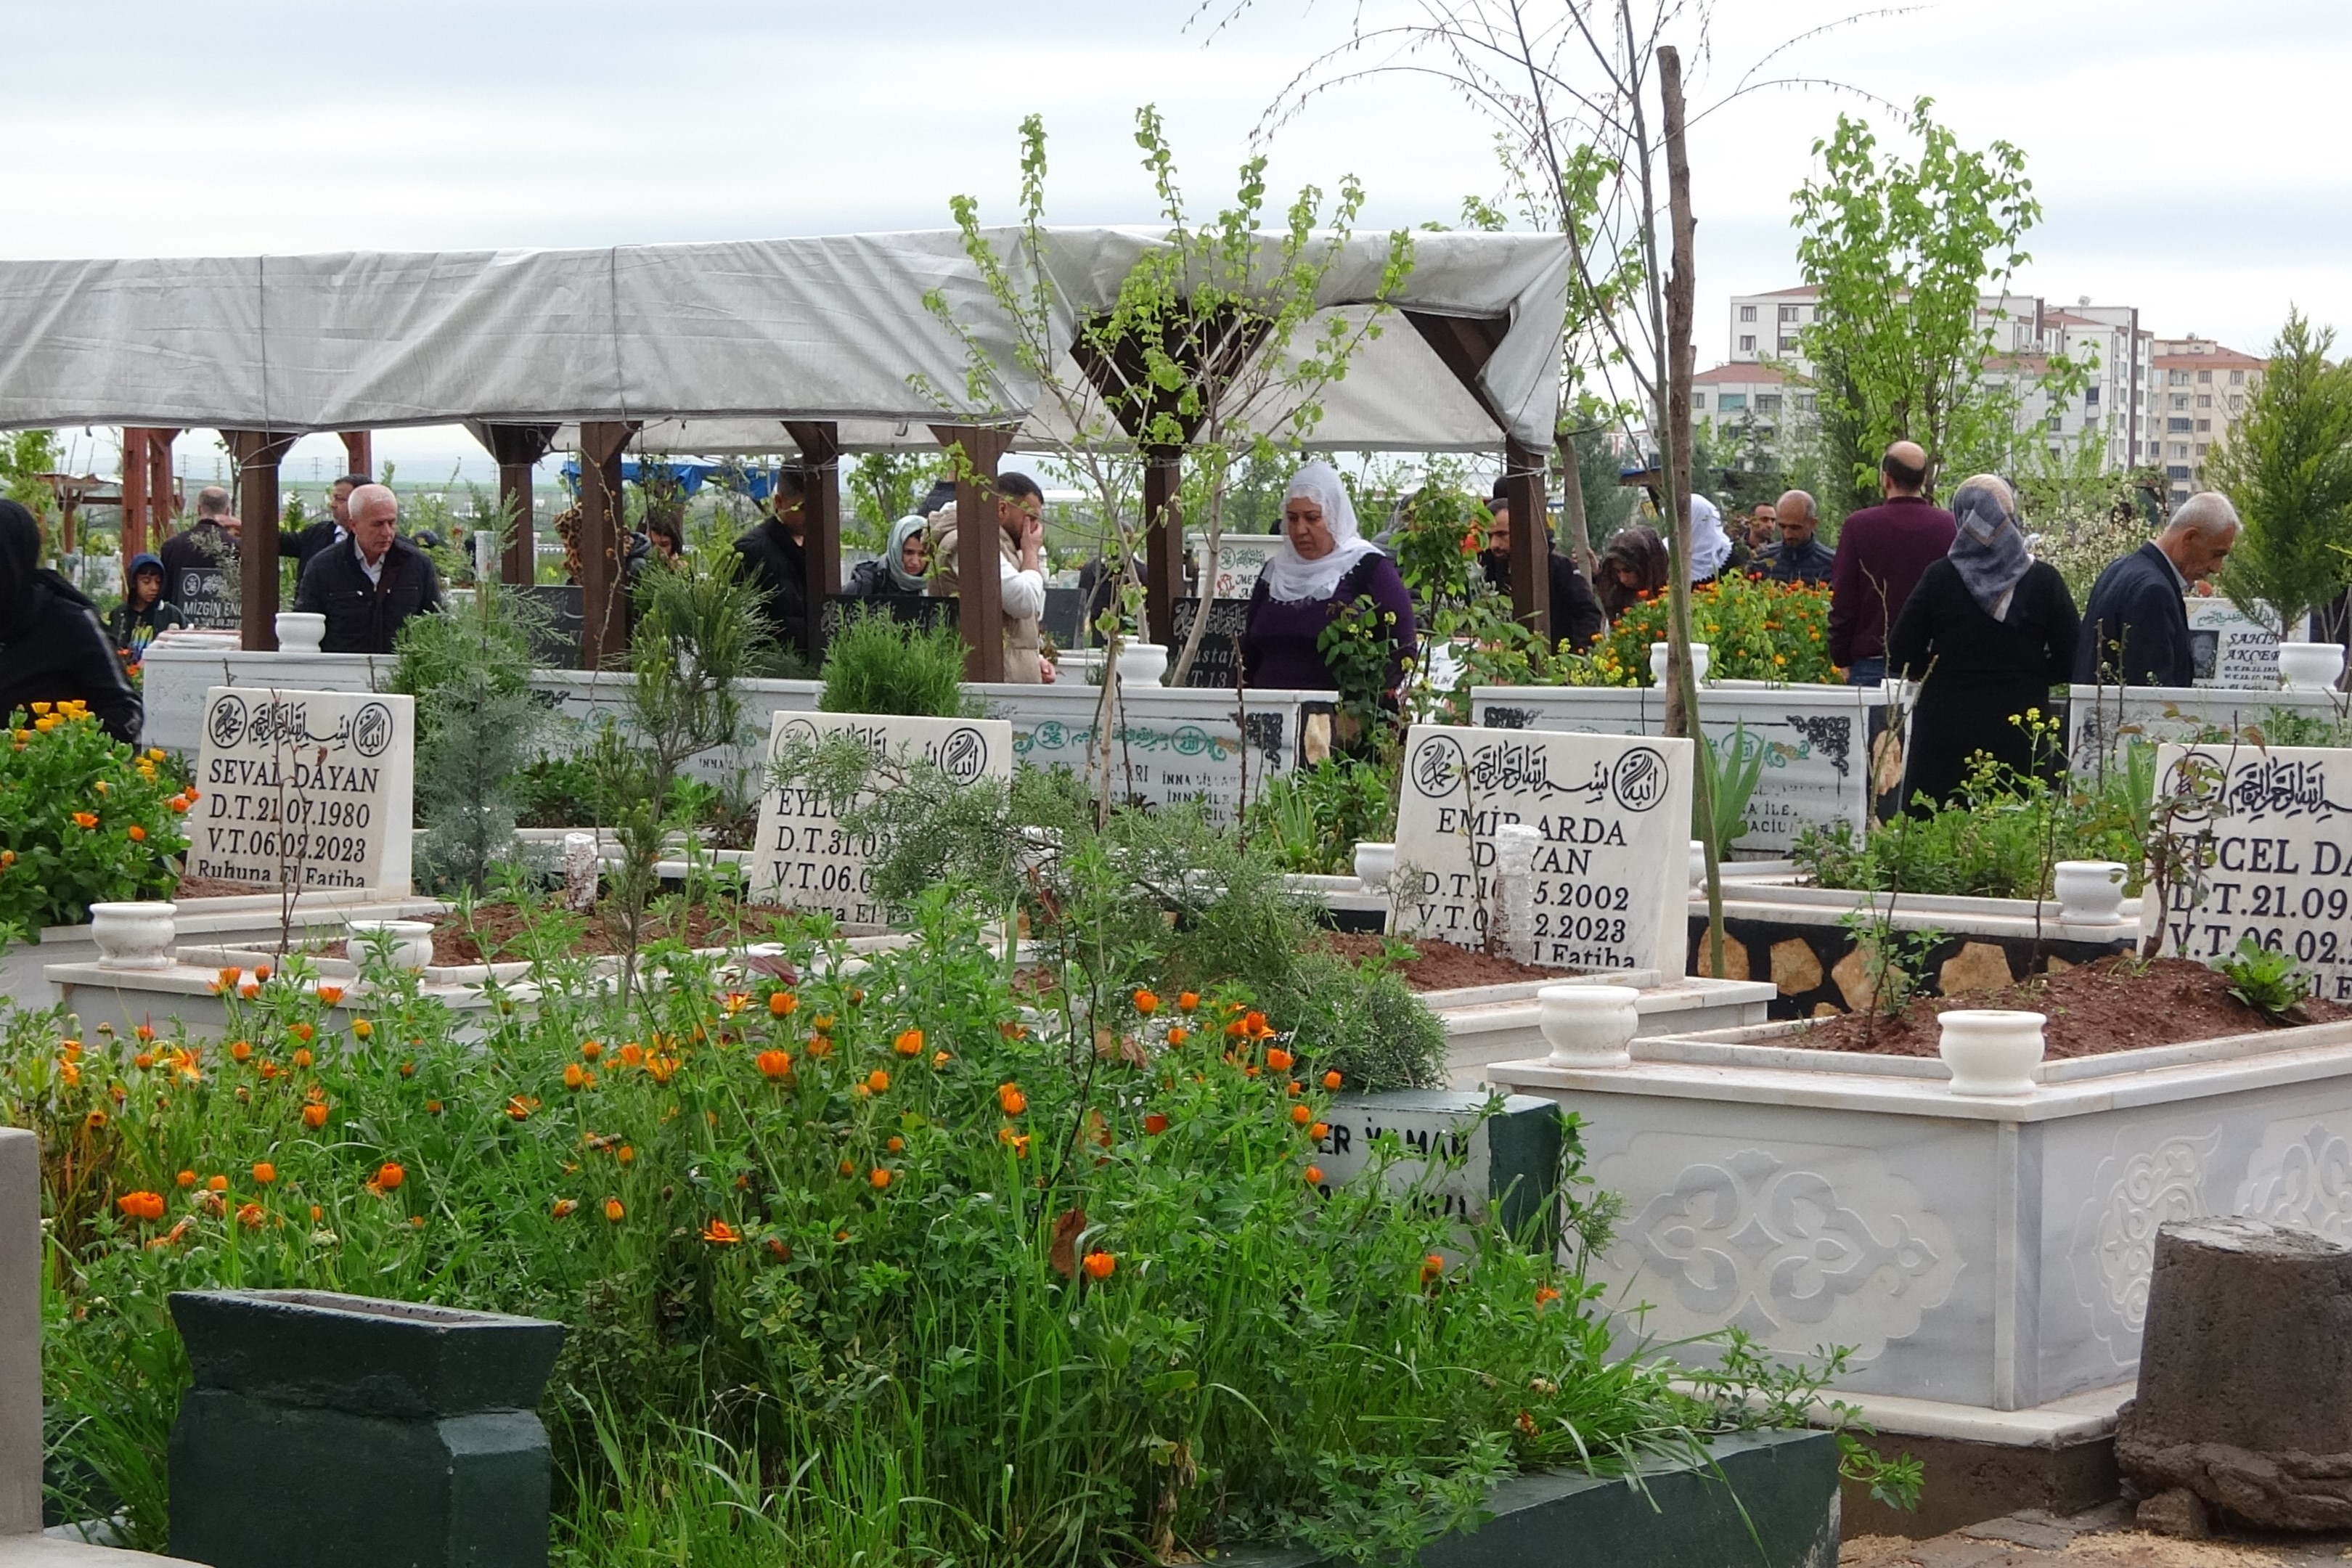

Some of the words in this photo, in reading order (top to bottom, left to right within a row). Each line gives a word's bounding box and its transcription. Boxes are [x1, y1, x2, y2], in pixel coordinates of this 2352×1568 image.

[291, 764, 380, 793] DAYAN
[208, 793, 370, 829] D.T.2107.1980
[208, 828, 367, 863] V.T.06.02.2023
[1536, 814, 1628, 846] ARDA
[198, 859, 271, 881] Ruhuna
[306, 867, 365, 889] Fatiha
[1476, 841, 1593, 876] DYAN
[1421, 872, 1630, 911] D.T.15.2002
[1416, 904, 1627, 943] V.T.02.2023
